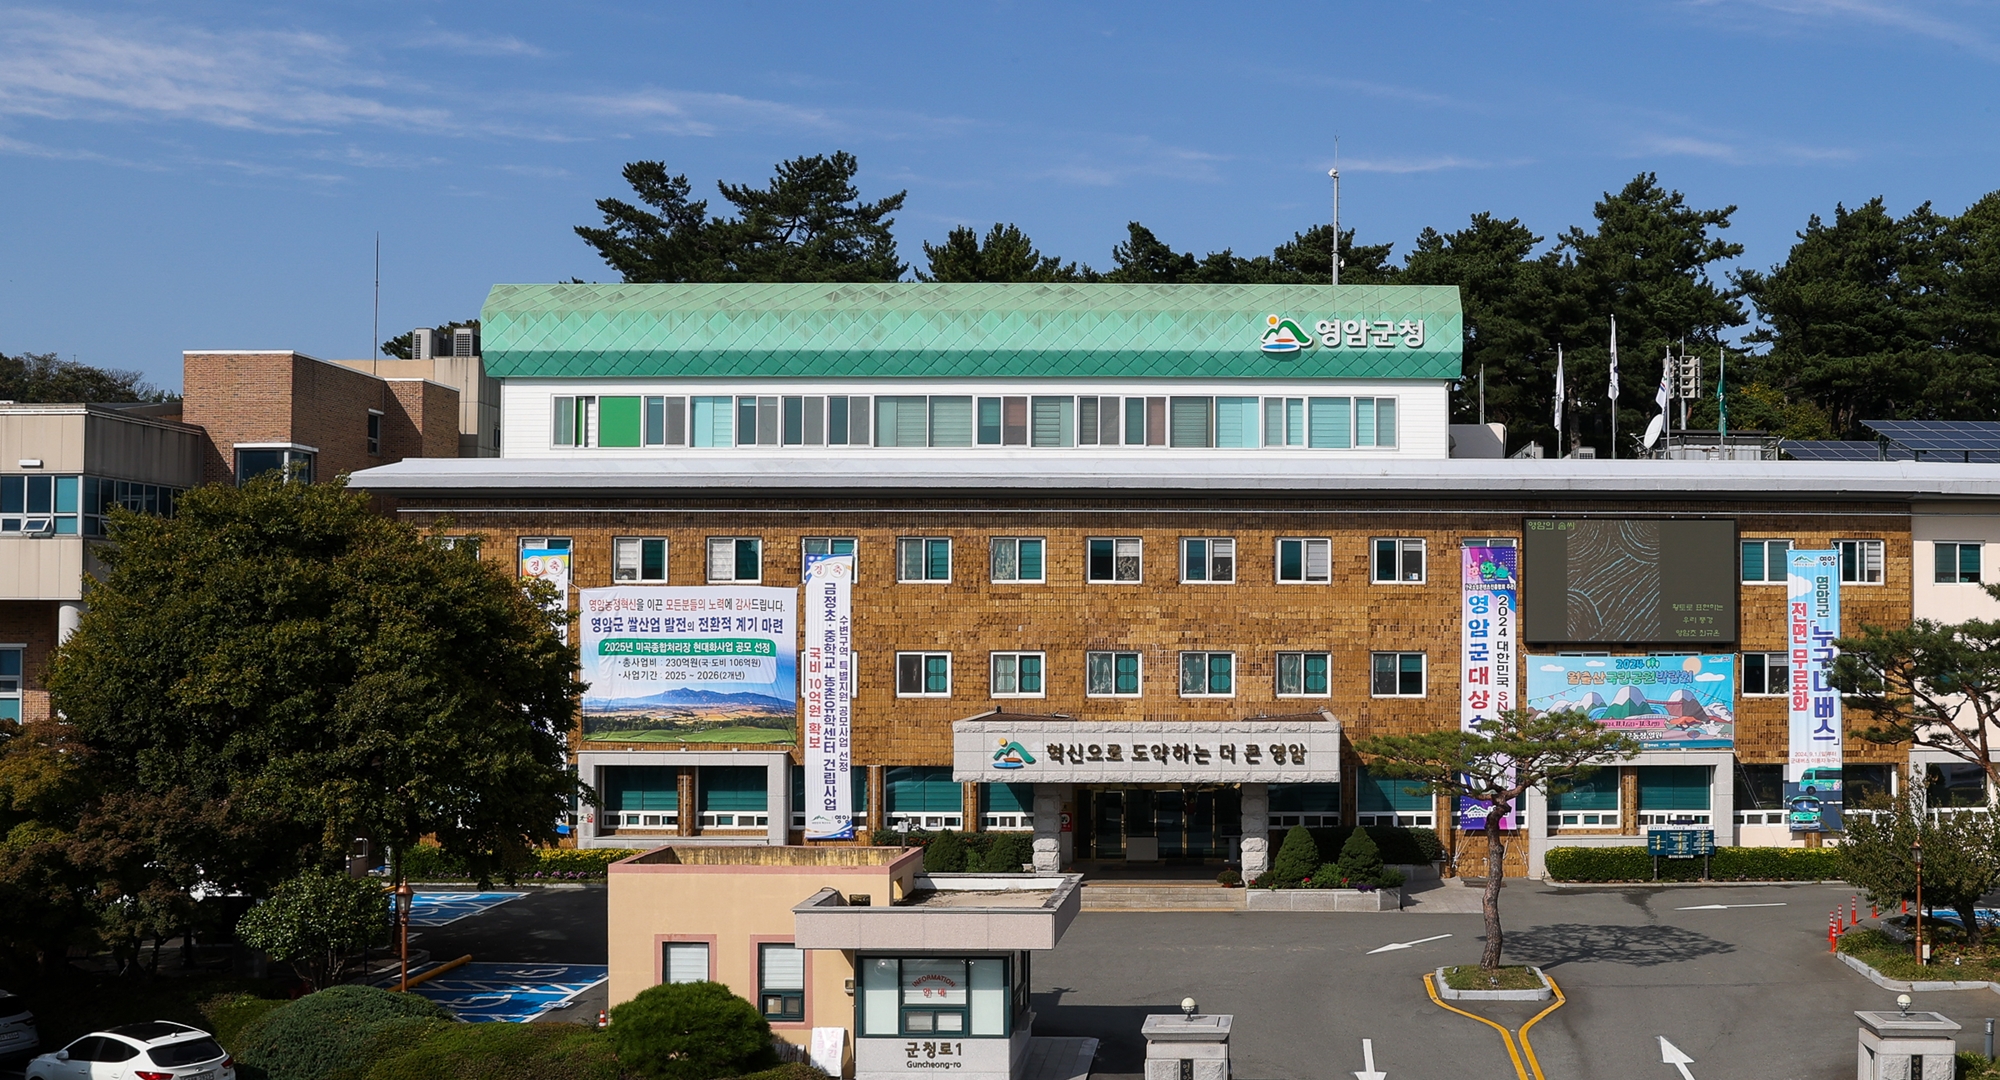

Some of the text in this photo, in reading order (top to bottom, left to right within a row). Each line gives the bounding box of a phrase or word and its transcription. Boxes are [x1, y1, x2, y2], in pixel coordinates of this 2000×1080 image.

[1315, 318, 1424, 347] 영암군청
[1528, 521, 1575, 531] 영암의 솜씨
[589, 599, 785, 612] 영암농정혁신을 이끈 모든분들의 노력에 감사드립니다.
[1498, 596, 1508, 637] 2024
[1683, 616, 1697, 624] 우리
[591, 617, 783, 634] 영암군 쌀산업 발전의 전환적 계기 마련
[1468, 595, 1490, 661] 영암군
[604, 642, 770, 654] 2025년 미곡종합처리장 현대화사업 공모 선정
[729, 658, 761, 668] 106억원)
[1496, 641, 1510, 687] 대한민국
[1616, 659, 1645, 669] 2024
[1791, 603, 1809, 711] 전면 무료화
[623, 671, 658, 680] 사업기간
[665, 671, 687, 680] 2025
[697, 671, 745, 681] 2026(2개년)
[808, 647, 822, 749] 국비 10억원 확보
[823, 582, 837, 811] 금정초·중학교 농촌유학센터 건립사업
[839, 615, 849, 772] 수변구역 특별지원 공모사업 선정
[1046, 743, 1308, 765] 혁신으로 도약하는 더 큰 영암
[912, 974, 956, 988] INFORMATION
[906, 1061, 962, 1069] Guncheong-ro
